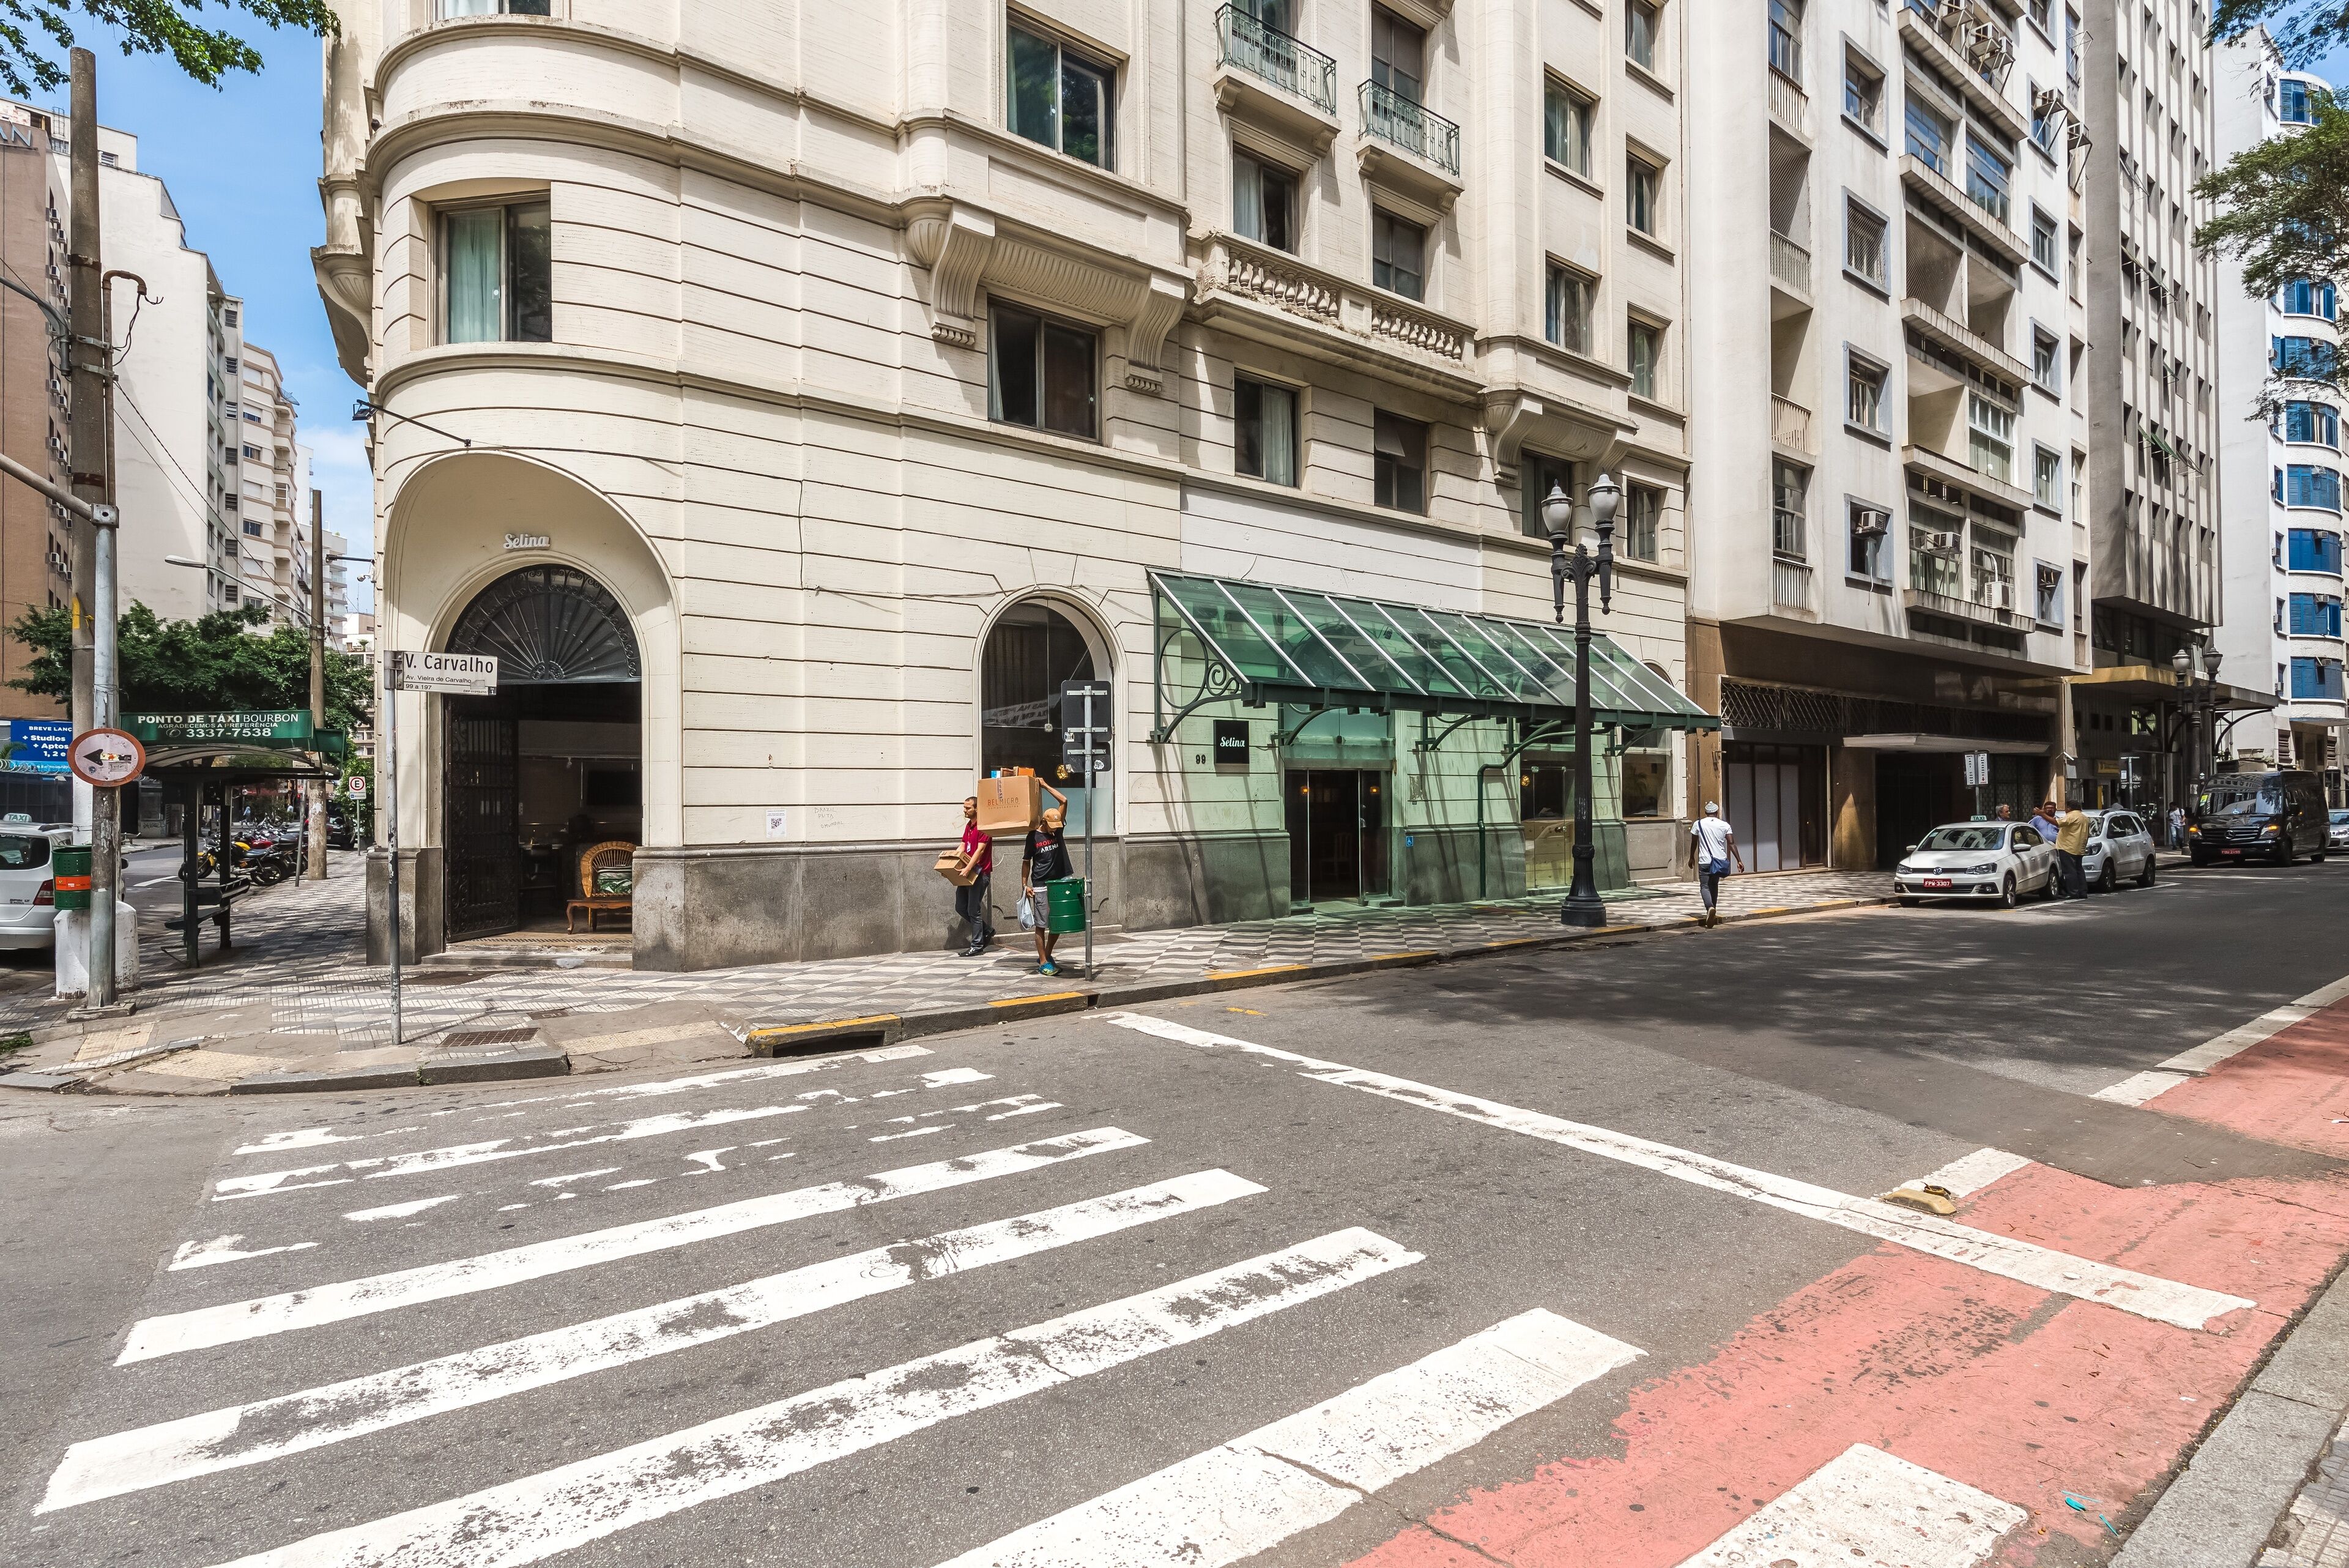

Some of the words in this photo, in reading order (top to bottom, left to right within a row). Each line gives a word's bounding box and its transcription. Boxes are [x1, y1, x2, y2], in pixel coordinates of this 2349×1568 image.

[503, 533, 551, 549] Selina
[405, 653, 417, 669] V.
[424, 655, 494, 674] Carvalho
[138, 715, 183, 724] PONTO
[187, 715, 204, 723] DE
[208, 713, 240, 723] TÁXI
[243, 713, 299, 723] BOURBON
[186, 728, 272, 738] 3337-7538
[1220, 736, 1245, 748] Selina
[1195, 754, 1206, 764] 99
[987, 797, 1019, 806] BELMICRO
[1041, 844, 1059, 853] ARENA
